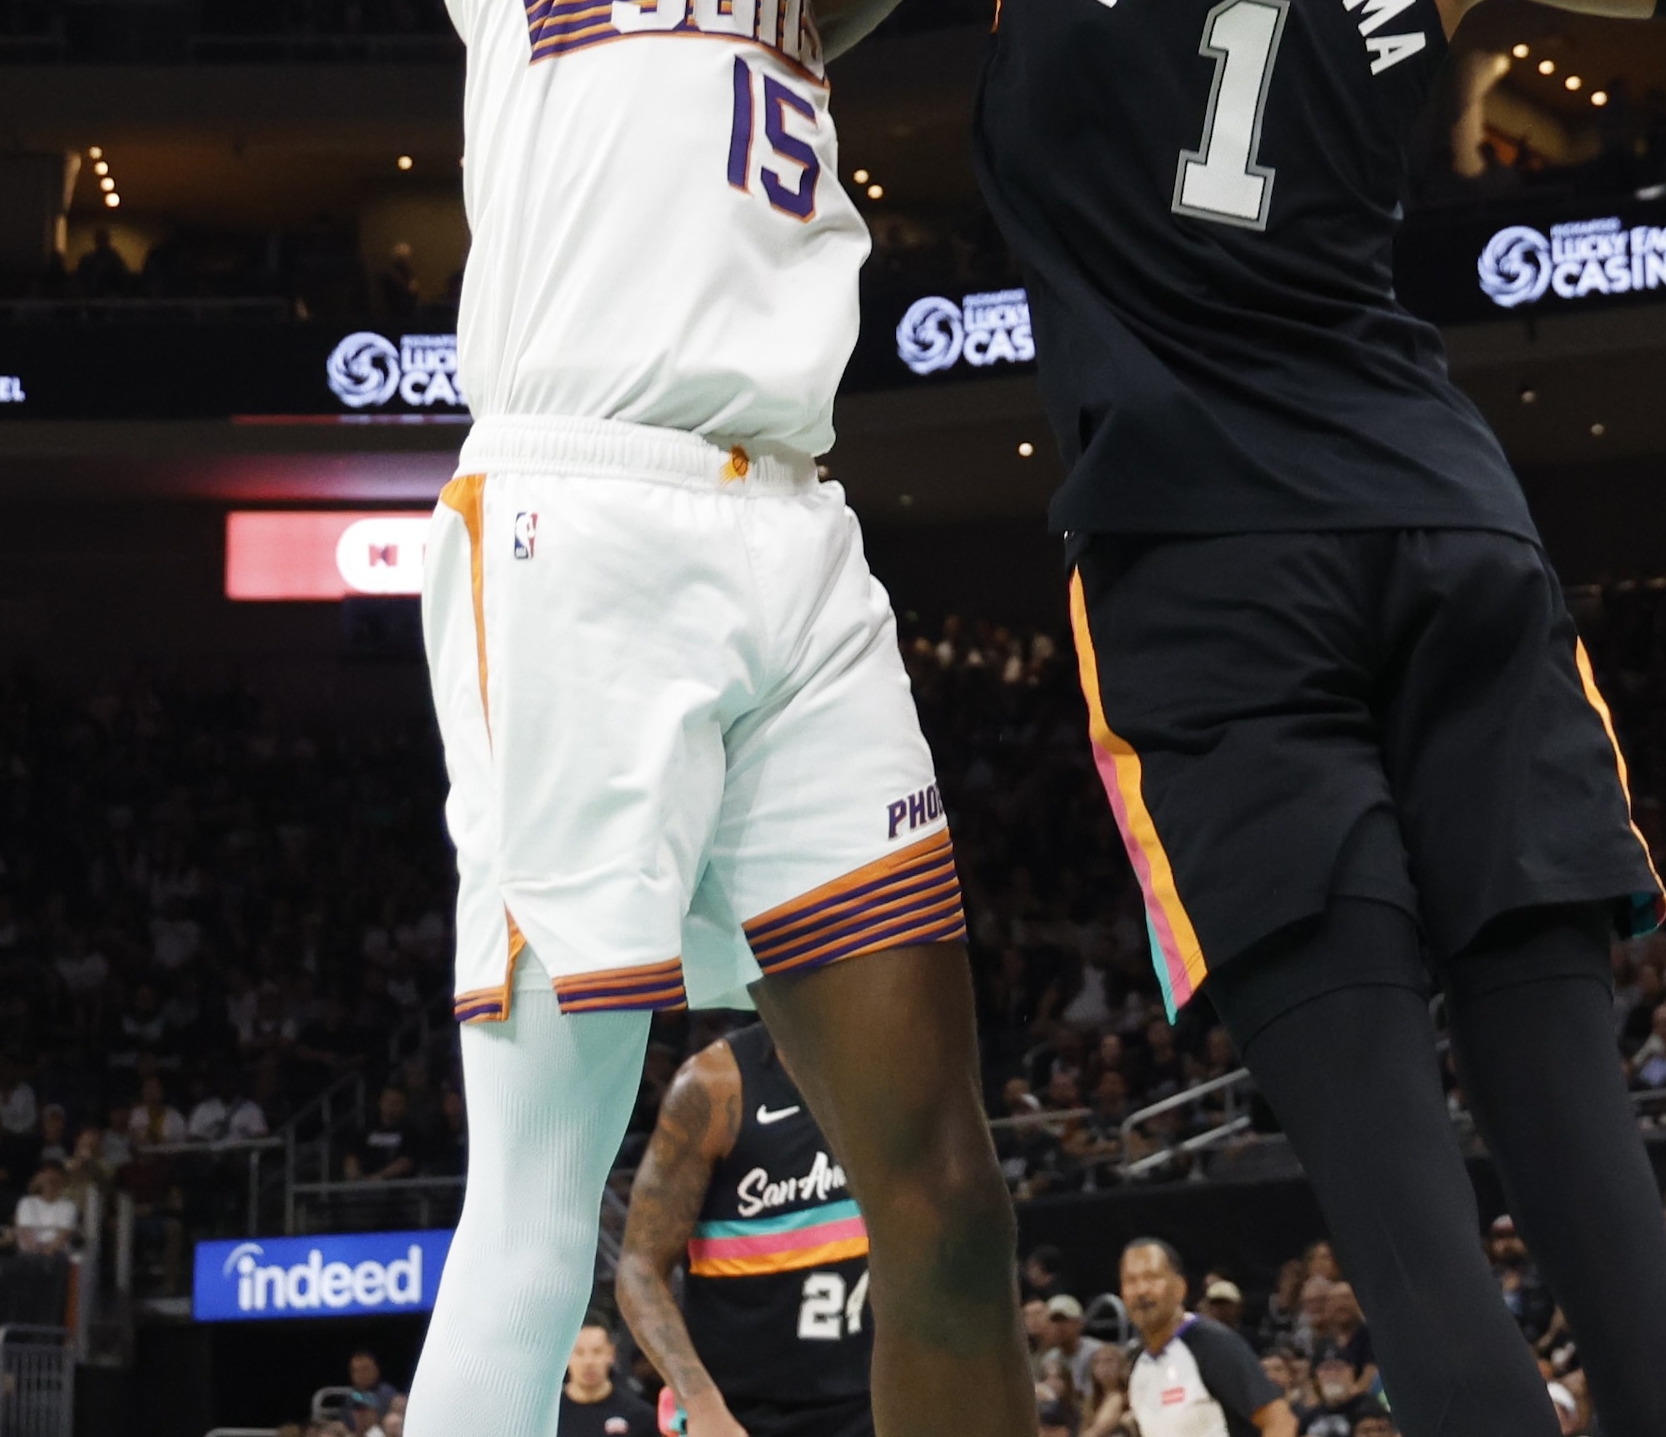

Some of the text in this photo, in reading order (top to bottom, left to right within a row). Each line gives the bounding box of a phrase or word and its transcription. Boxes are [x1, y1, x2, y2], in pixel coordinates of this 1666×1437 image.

[727, 54, 821, 224] 15
[963, 324, 1036, 367] CAS
[736, 1166, 798, 1218] San
[236, 1243, 424, 1312] indeed
